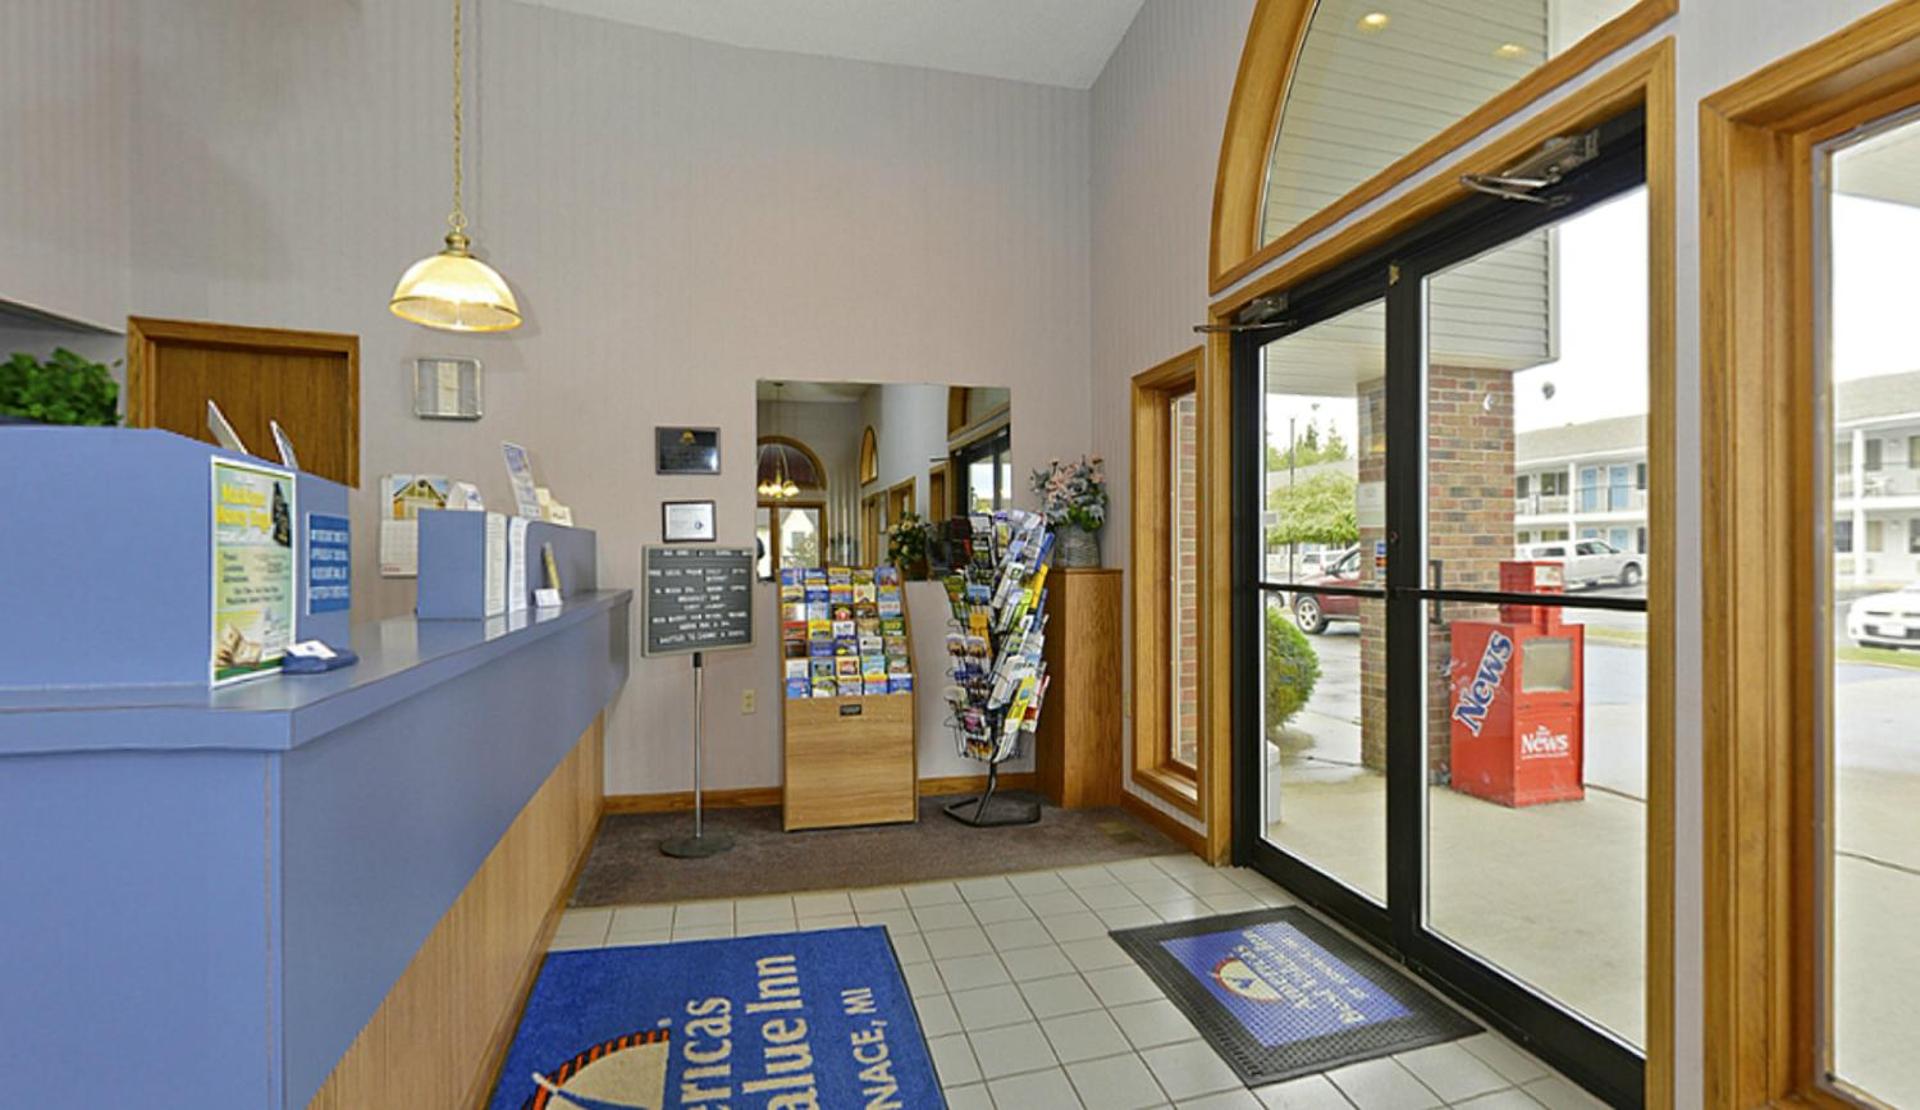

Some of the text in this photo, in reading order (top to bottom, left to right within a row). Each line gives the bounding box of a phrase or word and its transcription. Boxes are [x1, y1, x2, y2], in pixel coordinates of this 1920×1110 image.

[1453, 631, 1514, 736] News
[1521, 733, 1569, 754] News
[746, 954, 803, 1014] Inn
[841, 988, 877, 1016] MI
[681, 997, 733, 1110] ricas
